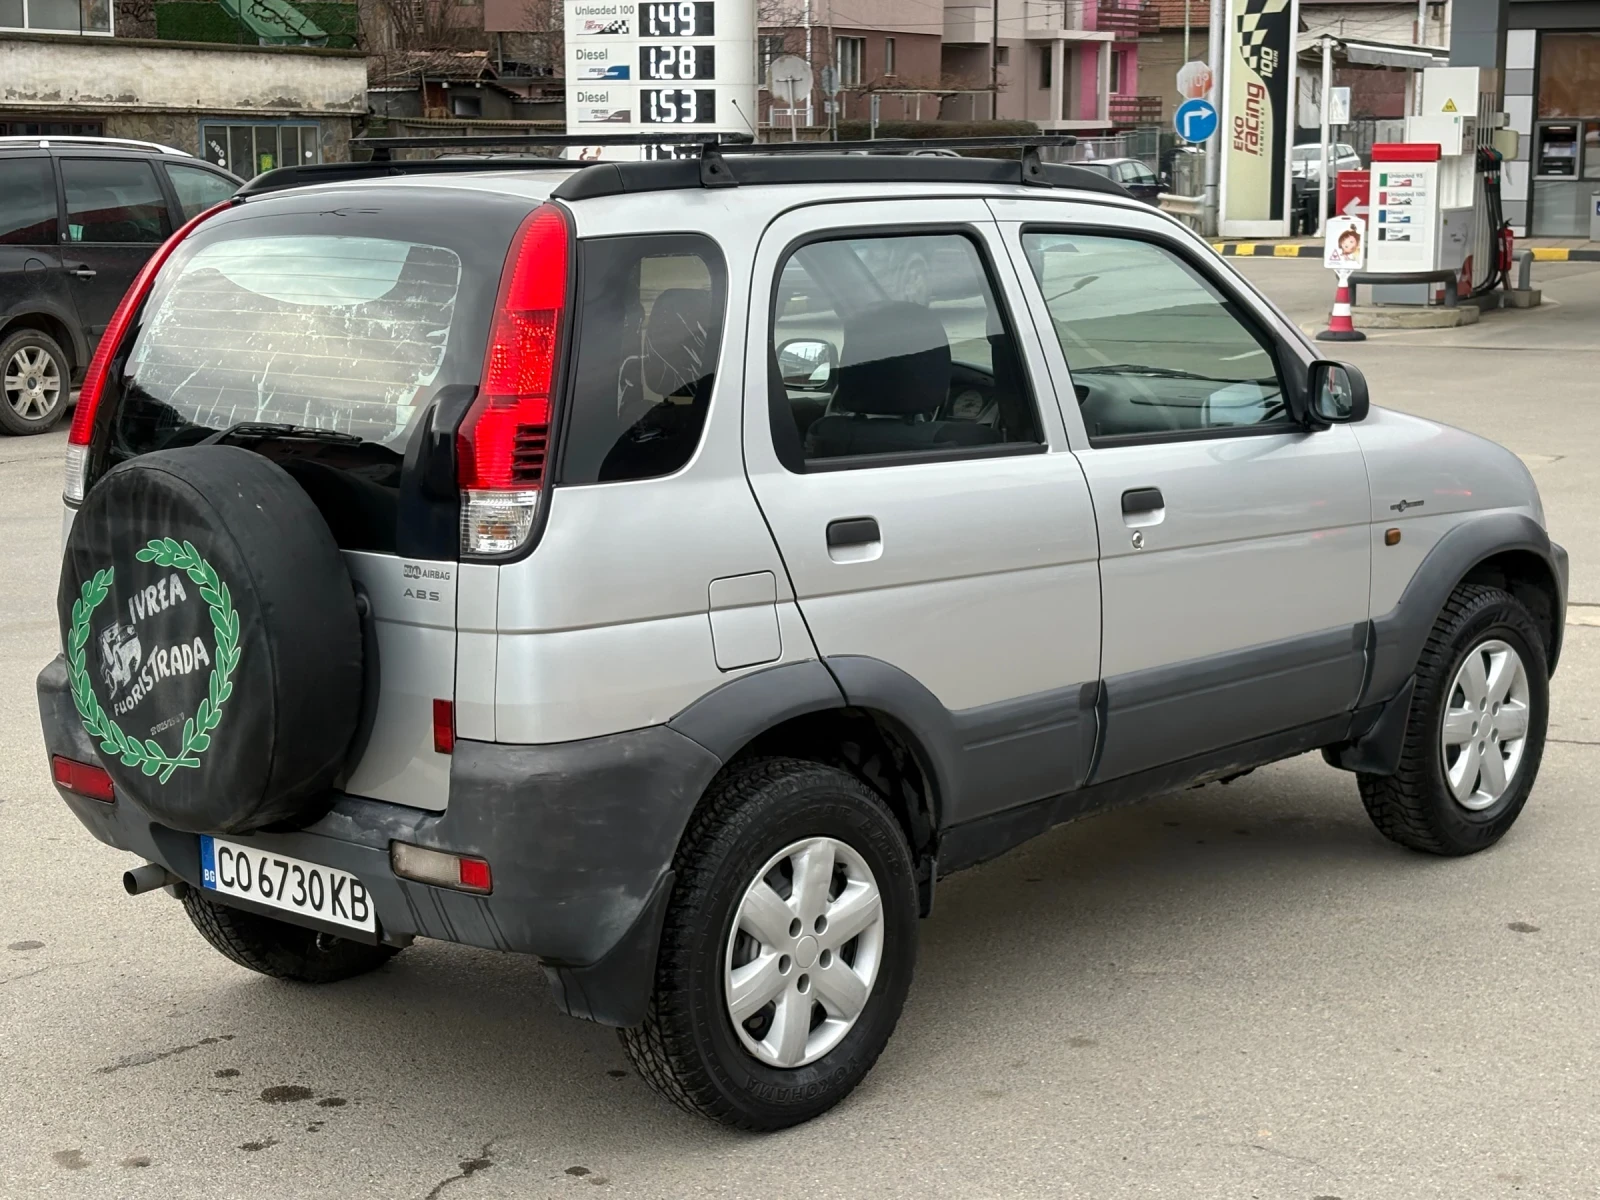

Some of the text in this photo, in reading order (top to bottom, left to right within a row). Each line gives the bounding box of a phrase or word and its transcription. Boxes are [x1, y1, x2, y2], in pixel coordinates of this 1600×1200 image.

[575, 5, 634, 16] Unleaded 100
[649, 2, 696, 36] 1.49
[576, 49, 608, 61] Diesel
[650, 46, 696, 79] 1.28
[1260, 46, 1273, 78] 100
[577, 91, 609, 103] Diesel
[651, 89, 697, 123] 1.53
[1233, 115, 1244, 151] EKO
[1244, 82, 1265, 155] racing
[422, 569, 451, 581] AIRBAG
[128, 573, 187, 624] IVREA
[403, 588, 440, 602] ABS
[114, 636, 210, 717] FUORISTRADA
[204, 868, 216, 883] BG
[218, 846, 370, 923] CO 6730 KB
[745, 1056, 862, 1104] YOKOHAMA
